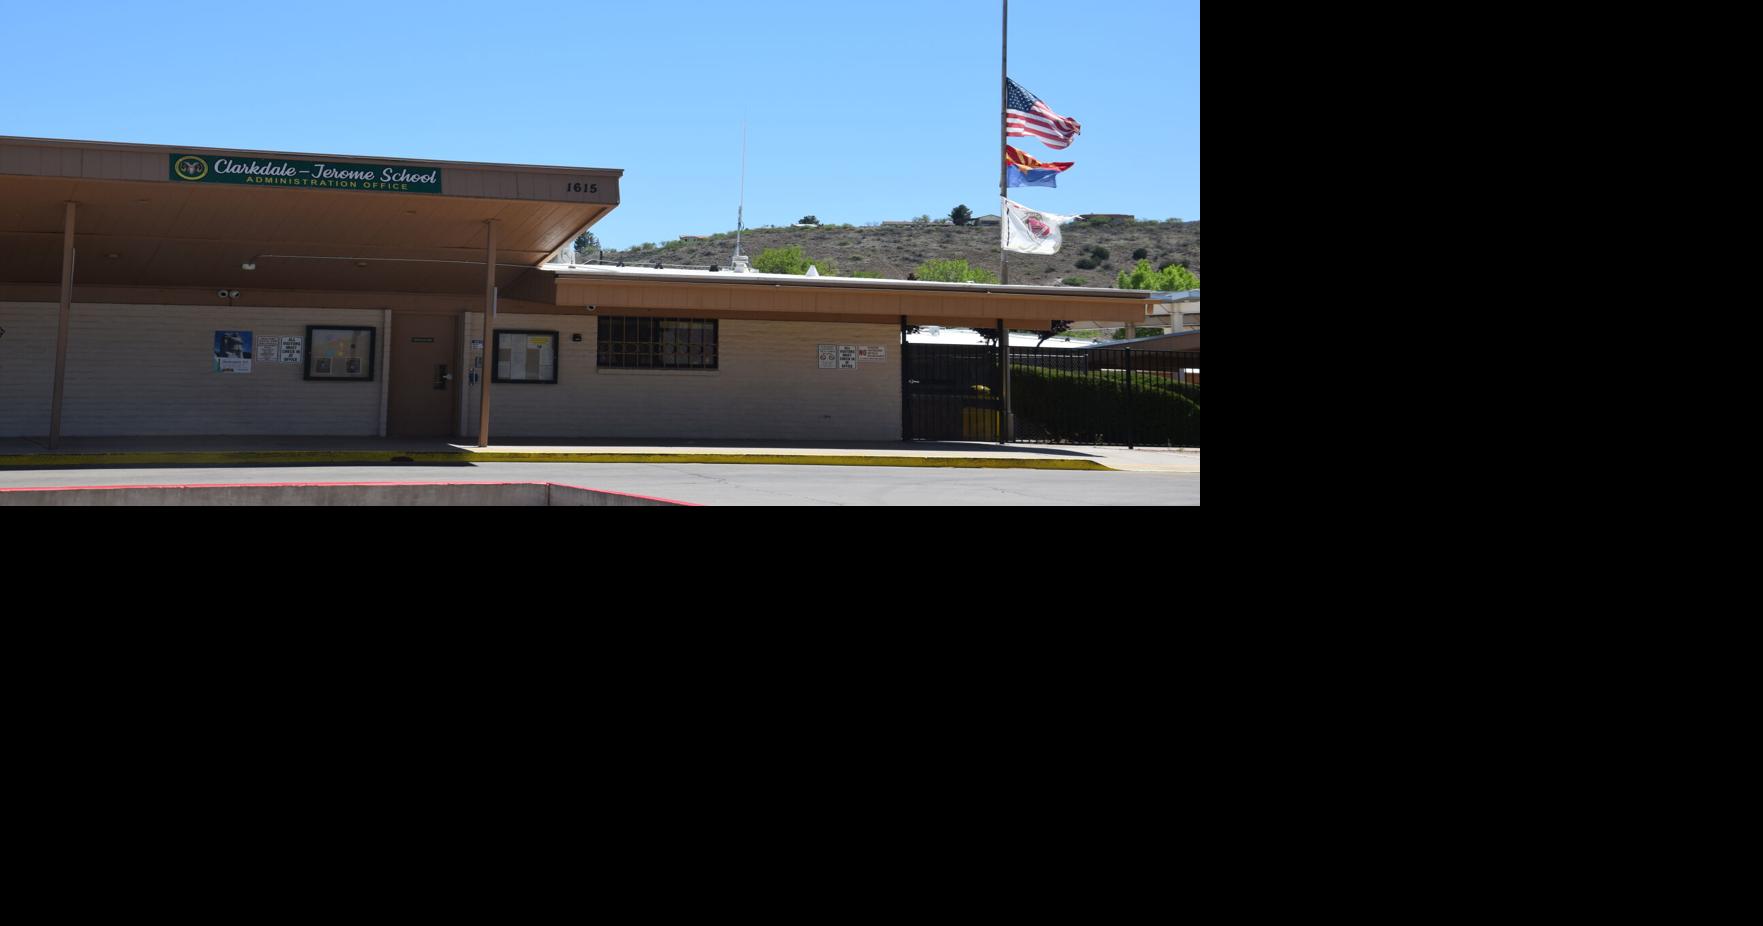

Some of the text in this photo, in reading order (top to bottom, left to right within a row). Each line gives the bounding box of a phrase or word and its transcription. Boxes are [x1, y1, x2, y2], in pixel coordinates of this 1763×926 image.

[214, 159, 297, 176] Clarkdale
[311, 164, 375, 180] Jerome
[380, 168, 437, 184] School
[246, 176, 408, 190] ADMINISTRATION OFFICE
[567, 182, 597, 193] 1615
